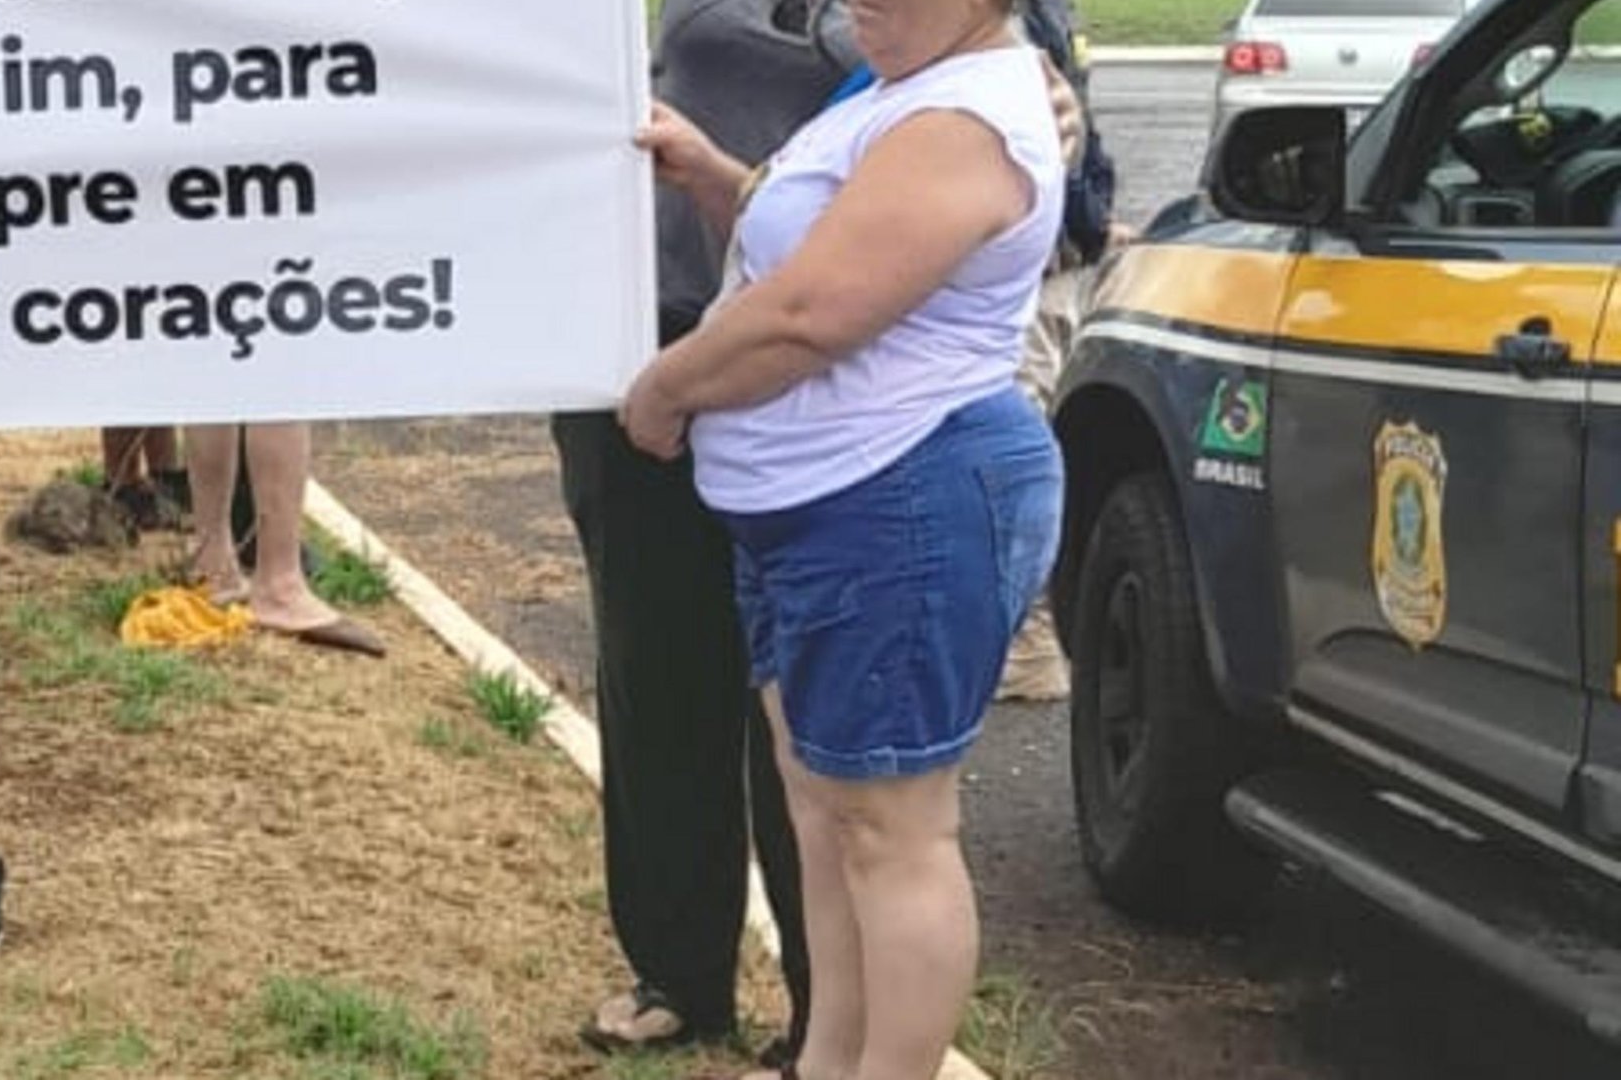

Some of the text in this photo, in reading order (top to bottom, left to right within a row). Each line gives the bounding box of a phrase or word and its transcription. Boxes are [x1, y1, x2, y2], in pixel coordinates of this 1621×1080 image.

[171, 38, 379, 126] para
[165, 159, 317, 222] em
[9, 257, 456, 361] corações!
[1193, 457, 1265, 490] BRASIL
